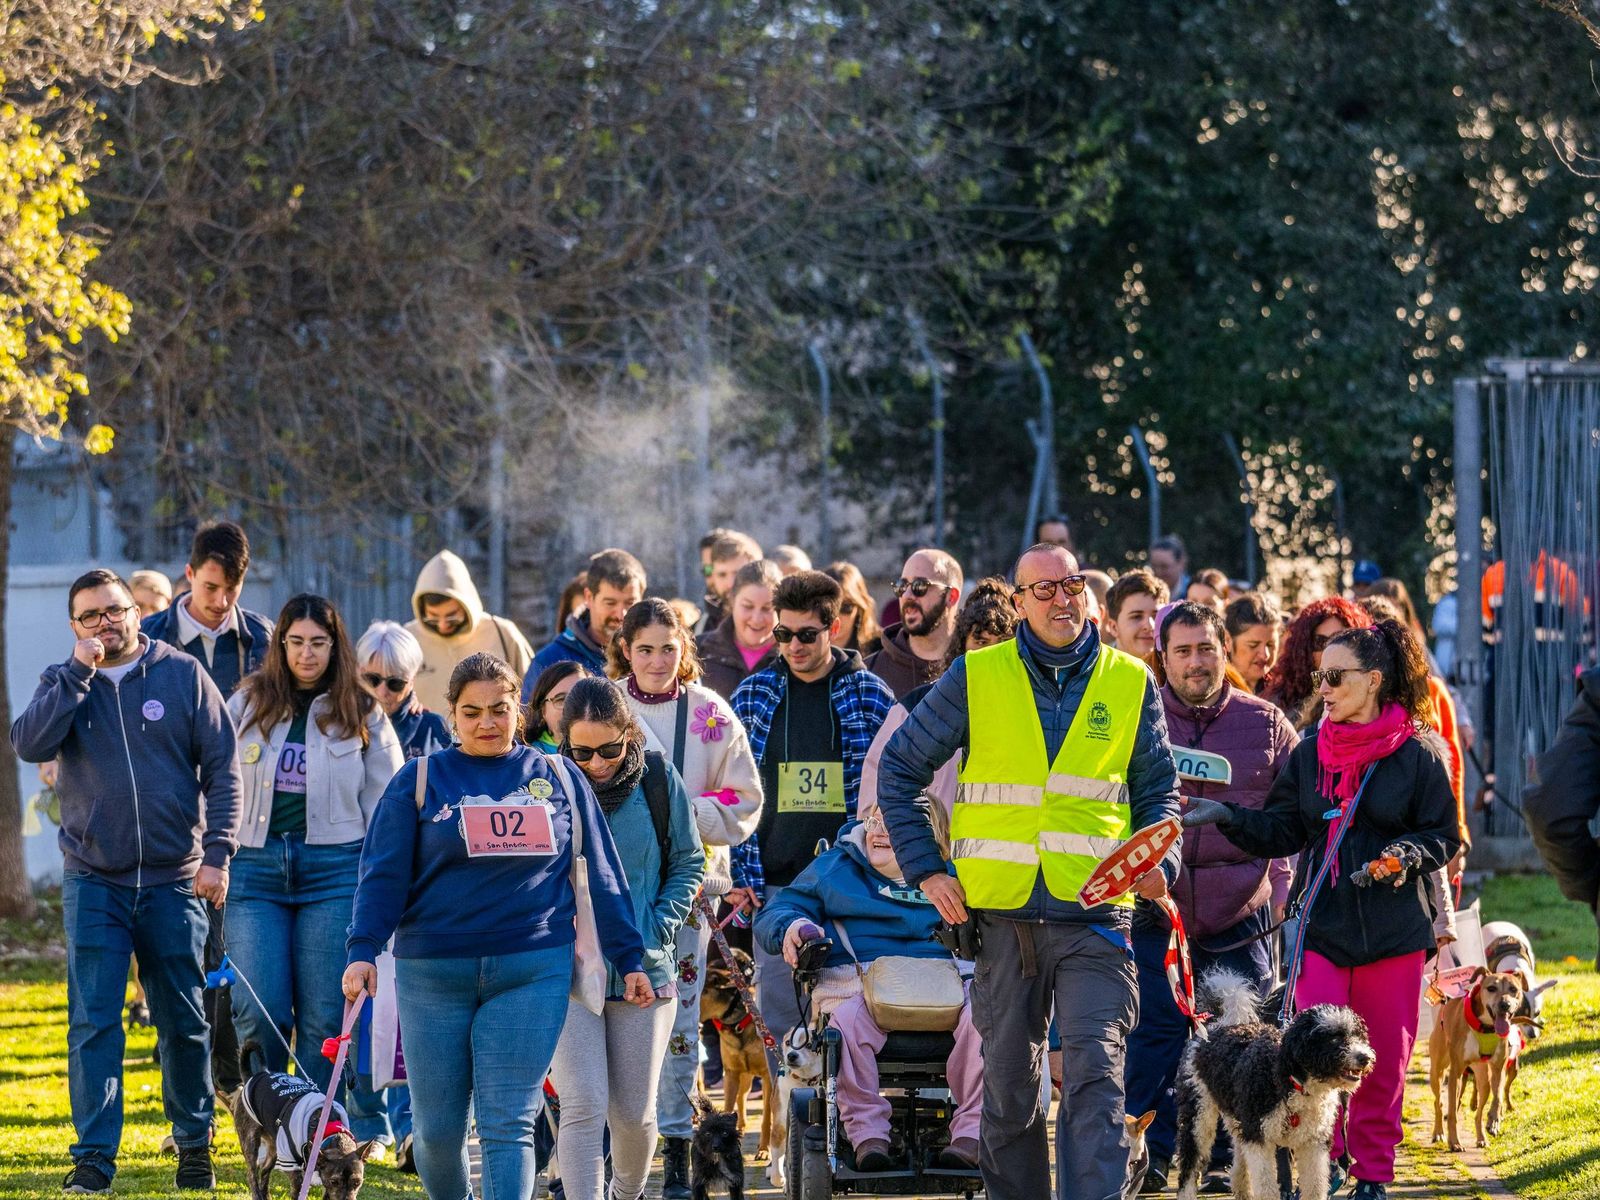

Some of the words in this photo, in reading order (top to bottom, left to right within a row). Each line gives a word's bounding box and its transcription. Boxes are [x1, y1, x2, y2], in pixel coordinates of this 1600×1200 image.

[281, 748, 306, 775] 08
[799, 768, 827, 794] 34
[490, 811, 526, 837] 02
[1085, 825, 1172, 901] STOP
